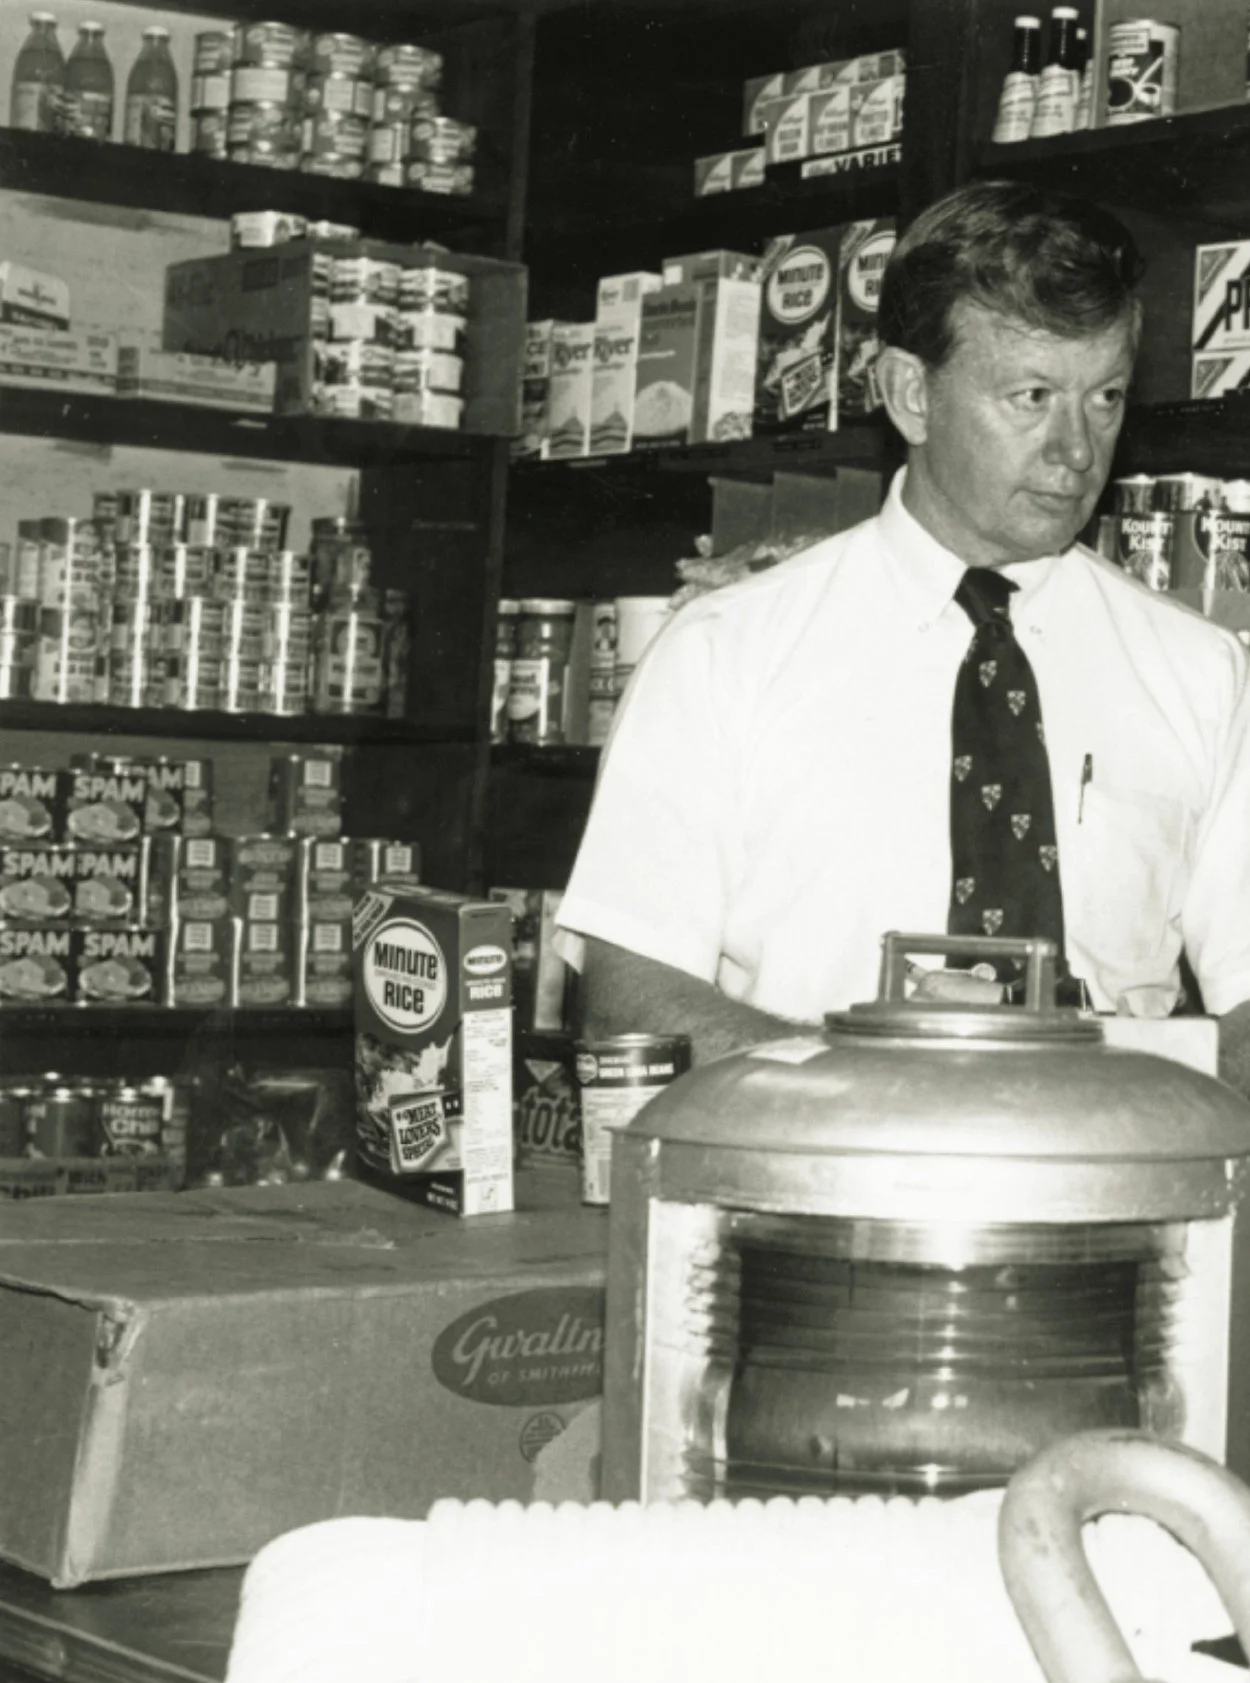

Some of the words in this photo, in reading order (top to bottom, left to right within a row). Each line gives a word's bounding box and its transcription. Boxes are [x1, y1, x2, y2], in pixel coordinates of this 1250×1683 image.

[74, 774, 145, 802] SPAM
[3, 851, 75, 877] SPAM
[0, 931, 70, 956] SPAM
[83, 932, 156, 957] SPAM
[374, 941, 439, 981] MINUTE
[384, 980, 425, 1015] RICE
